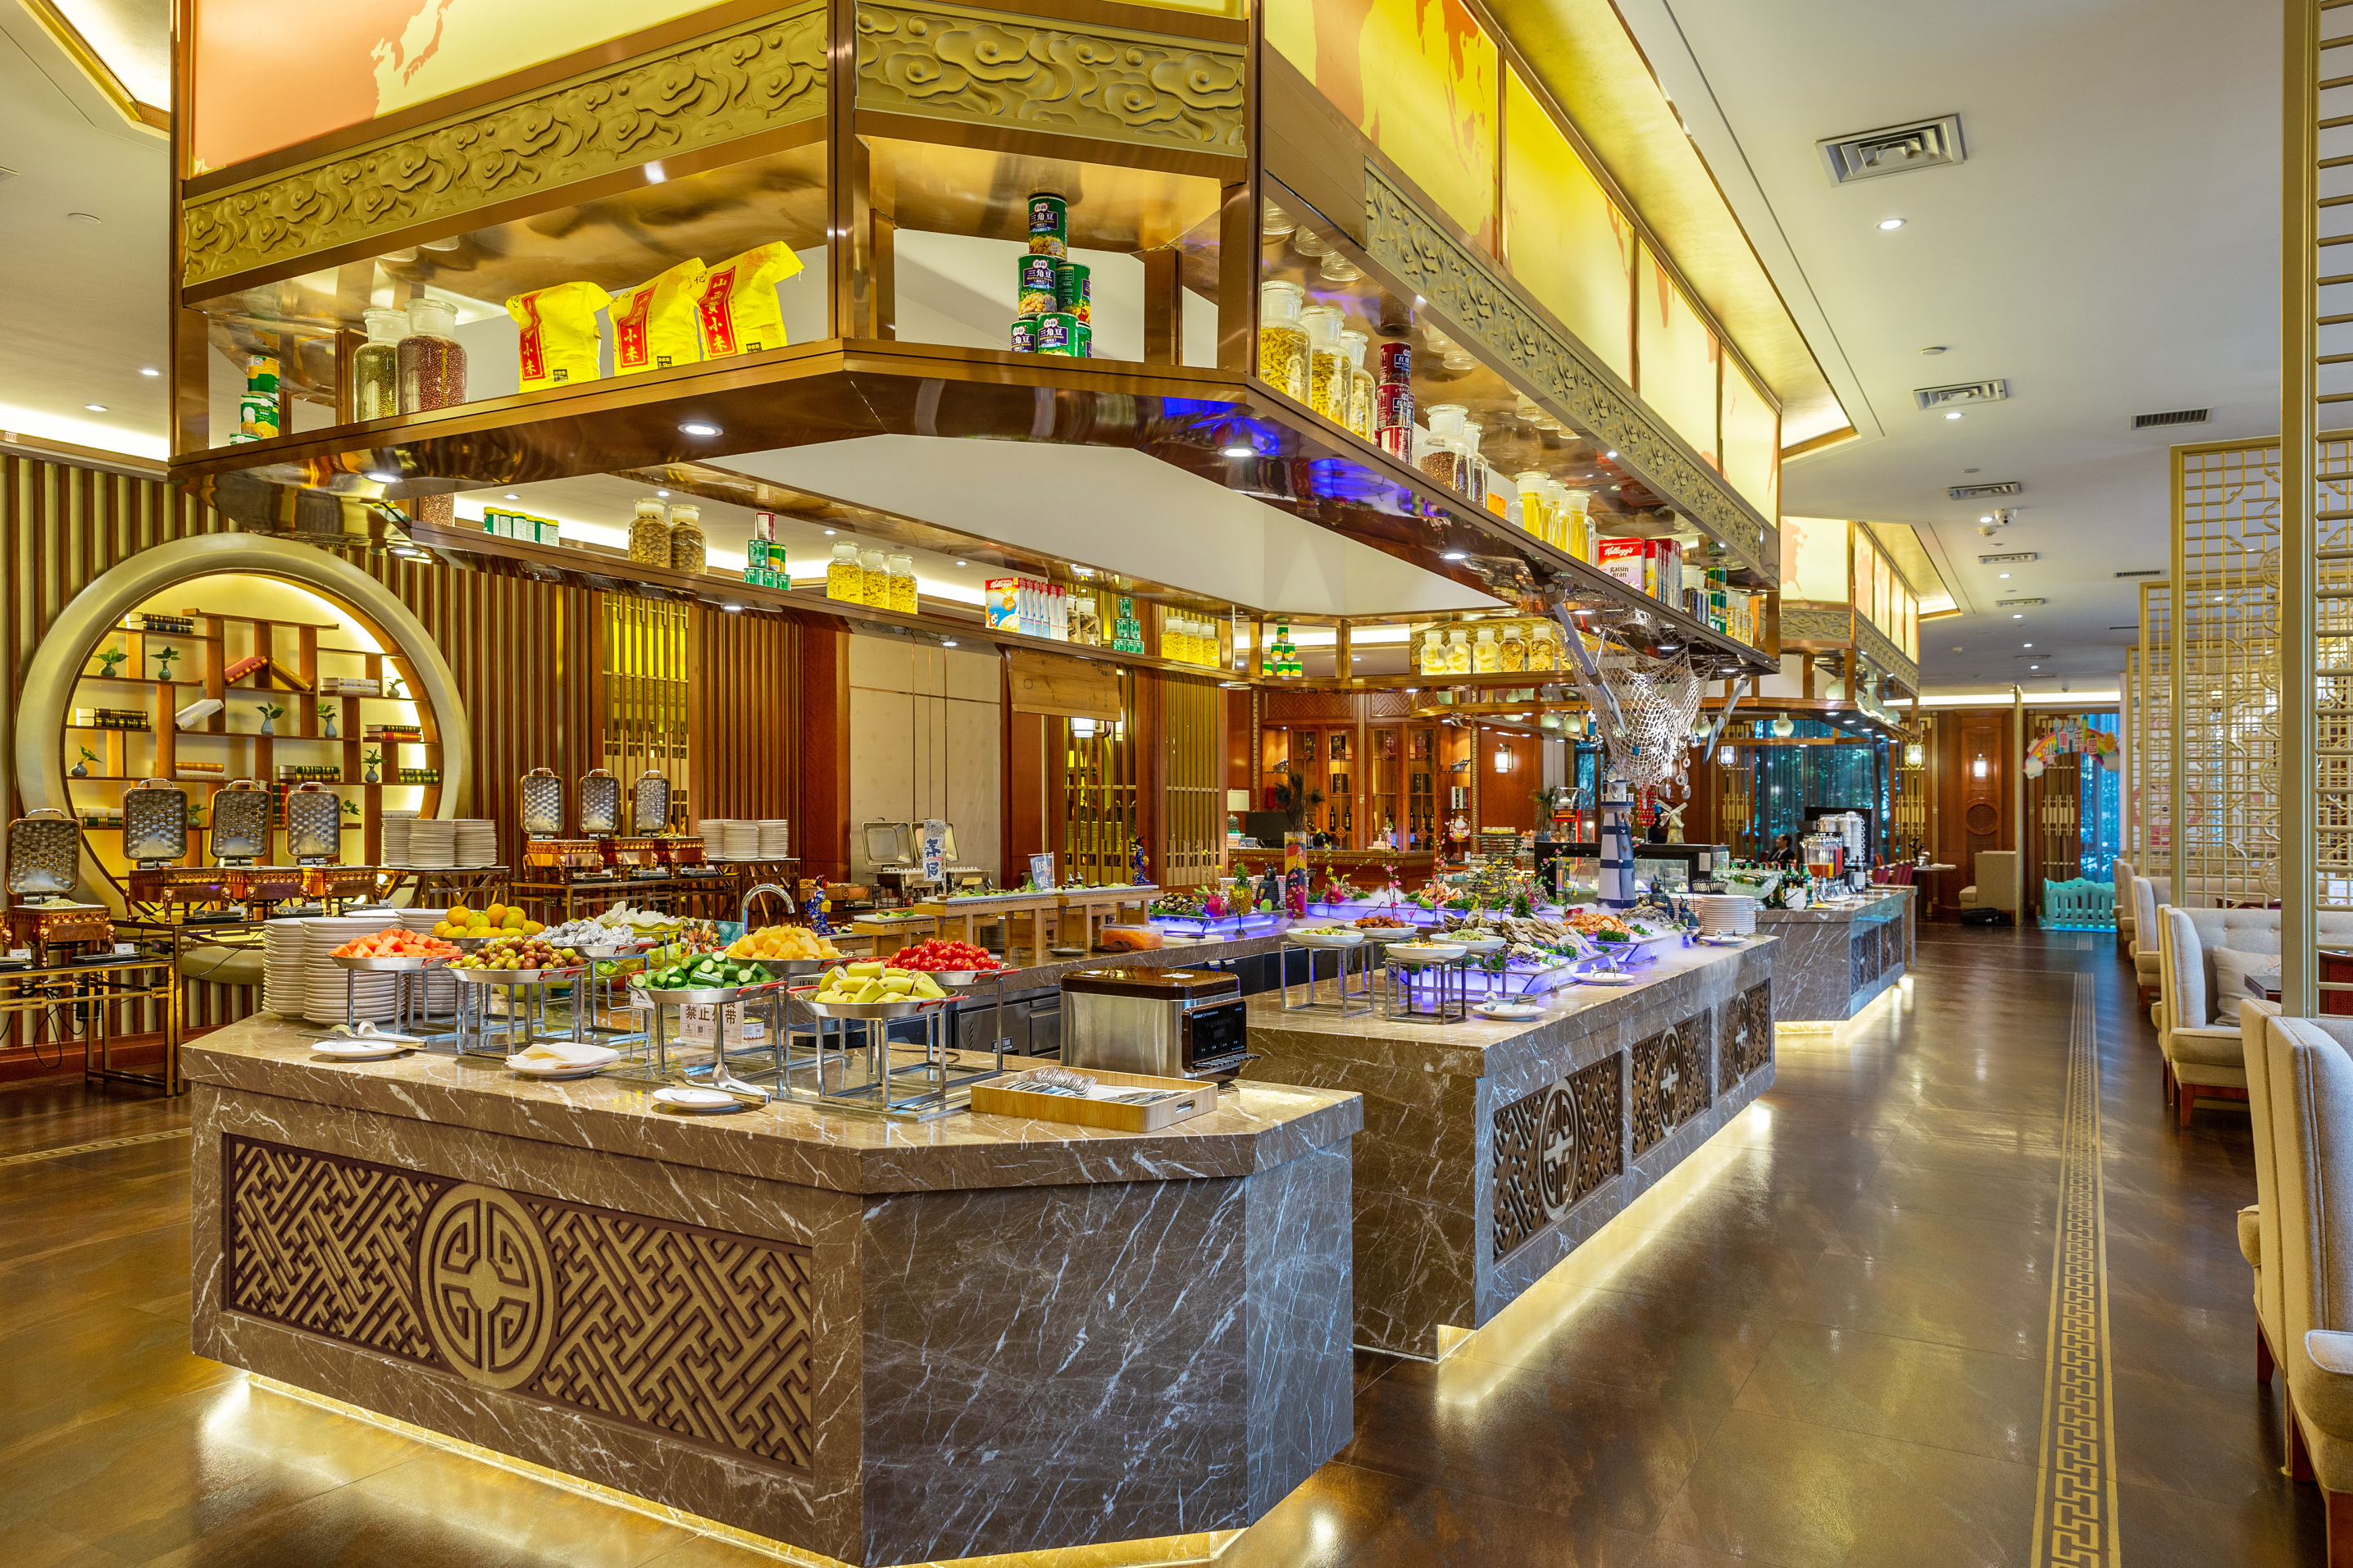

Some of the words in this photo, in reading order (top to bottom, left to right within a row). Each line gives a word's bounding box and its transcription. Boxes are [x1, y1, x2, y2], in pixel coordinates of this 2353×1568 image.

[1028, 269, 1052, 279] 三角豆
[1604, 546, 1634, 557] Kellogg's
[685, 1004, 737, 1025] 禁止带
